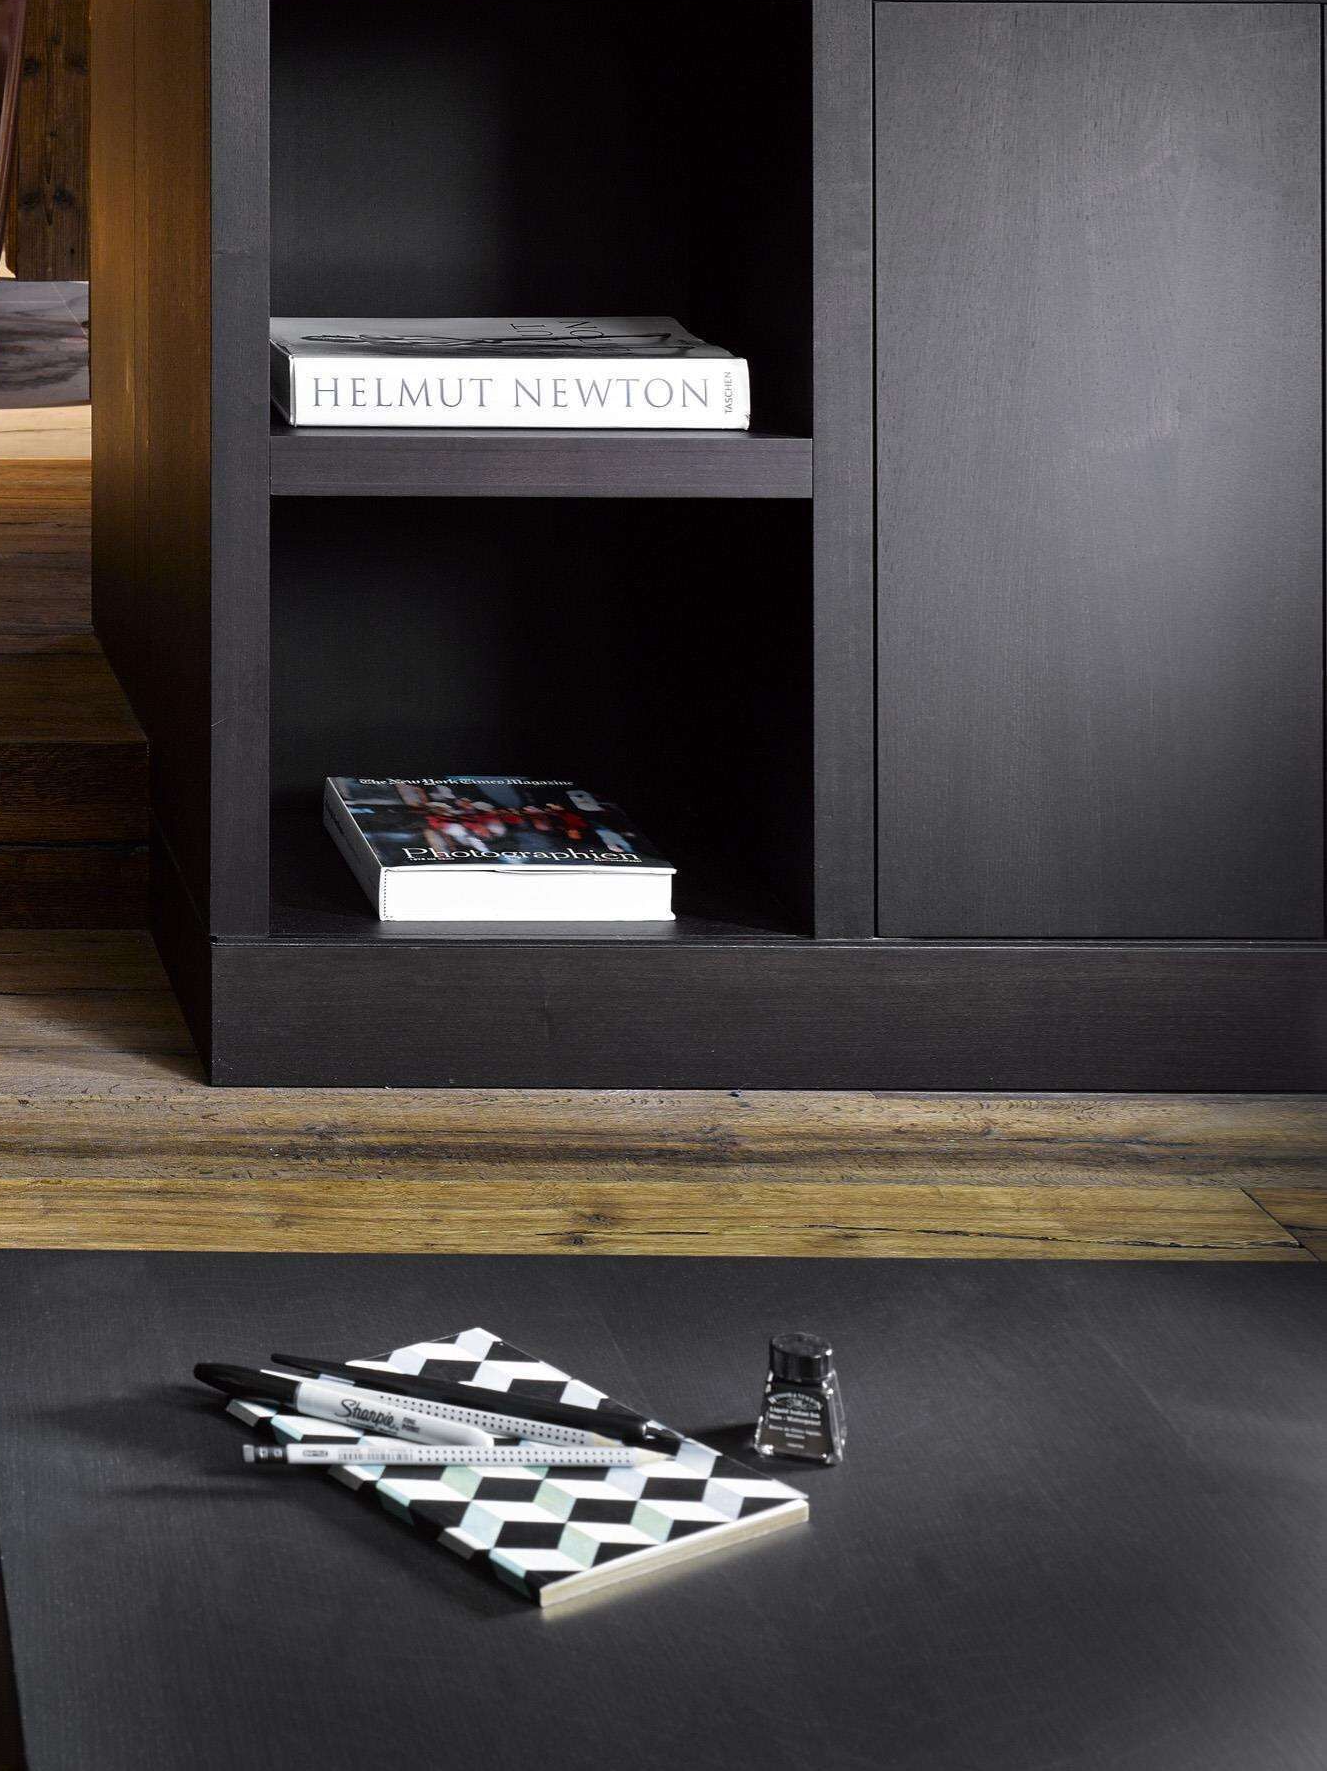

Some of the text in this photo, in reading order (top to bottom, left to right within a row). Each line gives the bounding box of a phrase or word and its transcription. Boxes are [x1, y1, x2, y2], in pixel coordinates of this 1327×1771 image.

[313, 377, 710, 409] HELMUT NEWTON
[723, 370, 733, 415] TASCHEN
[401, 847, 641, 863] Photographien
[334, 1398, 396, 1429] Sharpie
